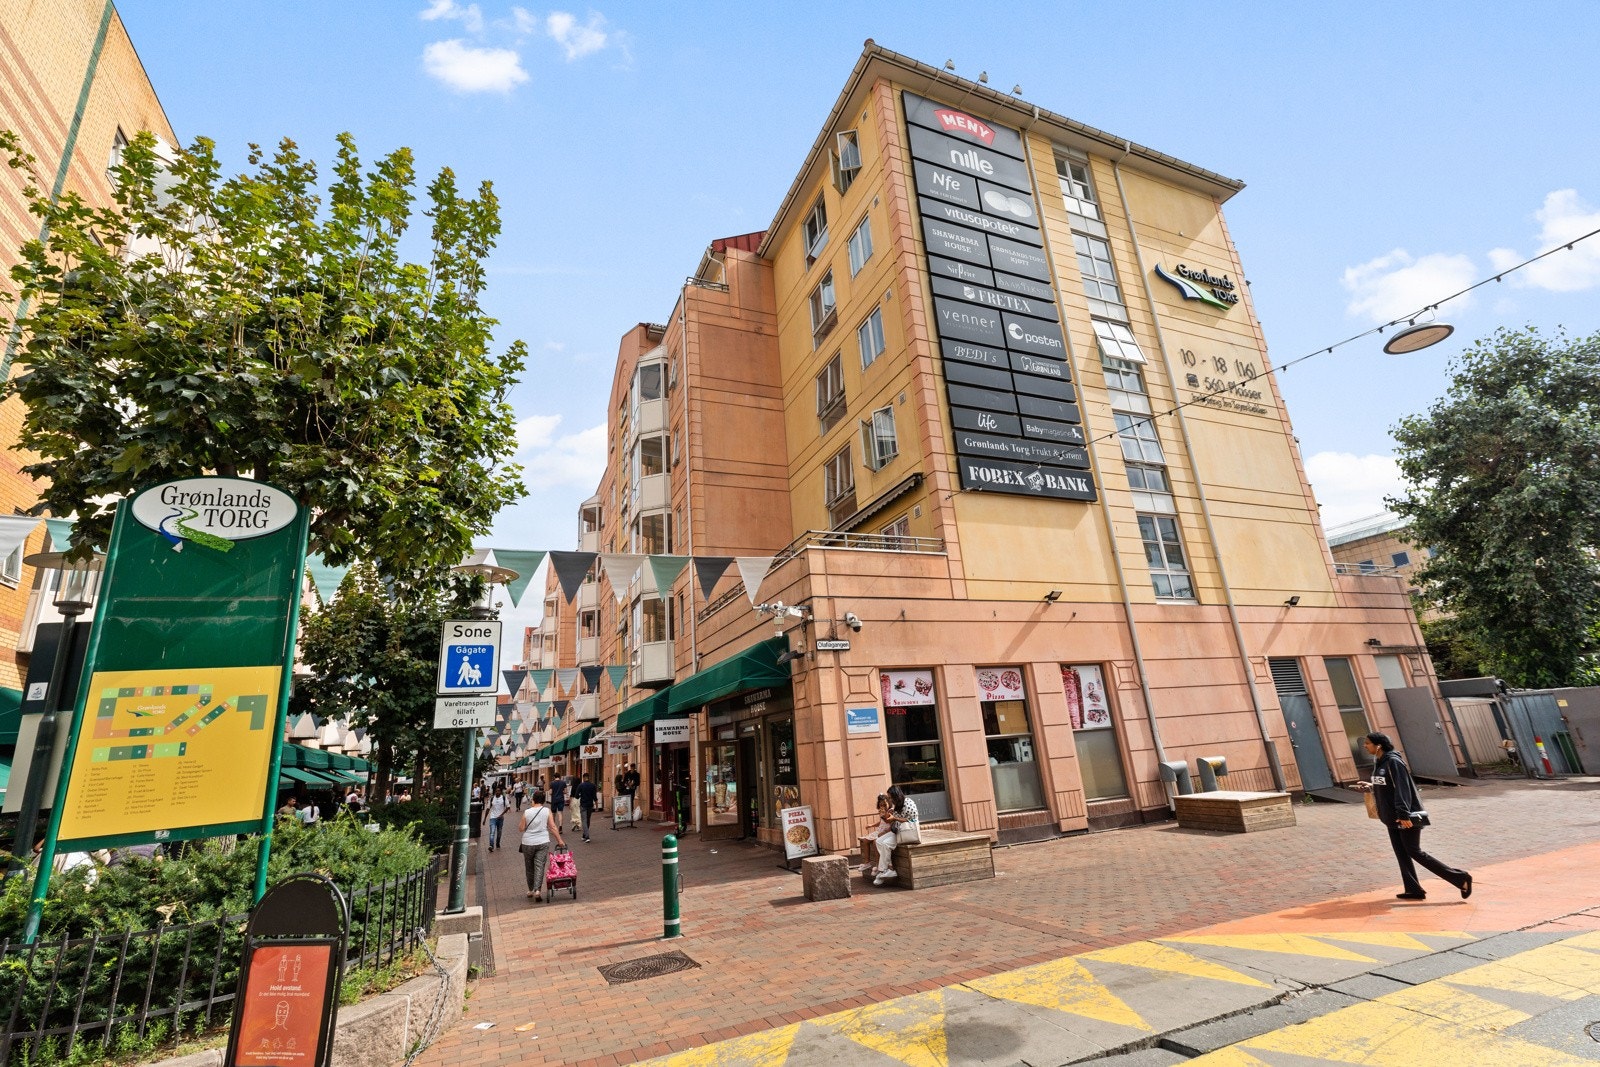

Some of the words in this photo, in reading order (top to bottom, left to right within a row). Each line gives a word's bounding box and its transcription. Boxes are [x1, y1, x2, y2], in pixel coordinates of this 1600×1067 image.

[942, 114, 990, 138] MENY
[950, 148, 994, 176] nille
[932, 171, 961, 191] Nfe
[932, 228, 980, 246] SHAWARMA
[944, 240, 972, 254] HOUSE
[1175, 263, 1236, 291] Grønlands
[978, 290, 1032, 312] FRETEX
[942, 308, 996, 330] venner
[1026, 332, 1062, 348] posten
[1180, 348, 1197, 367] 10
[1212, 356, 1228, 375] 18
[964, 438, 1009, 452] Grønlands
[1010, 444, 1030, 456] Torg
[1030, 445, 1052, 457] Frukt
[968, 466, 1026, 486] FOREX
[1046, 474, 1090, 492] BANK
[160, 484, 272, 509] Grønlands
[204, 508, 270, 530] TORG
[453, 625, 492, 638] Sone
[456, 646, 486, 656] Gågate
[444, 700, 489, 708] Varetransport
[456, 707, 476, 715] tillatt
[788, 817, 807, 825] KEBAB
